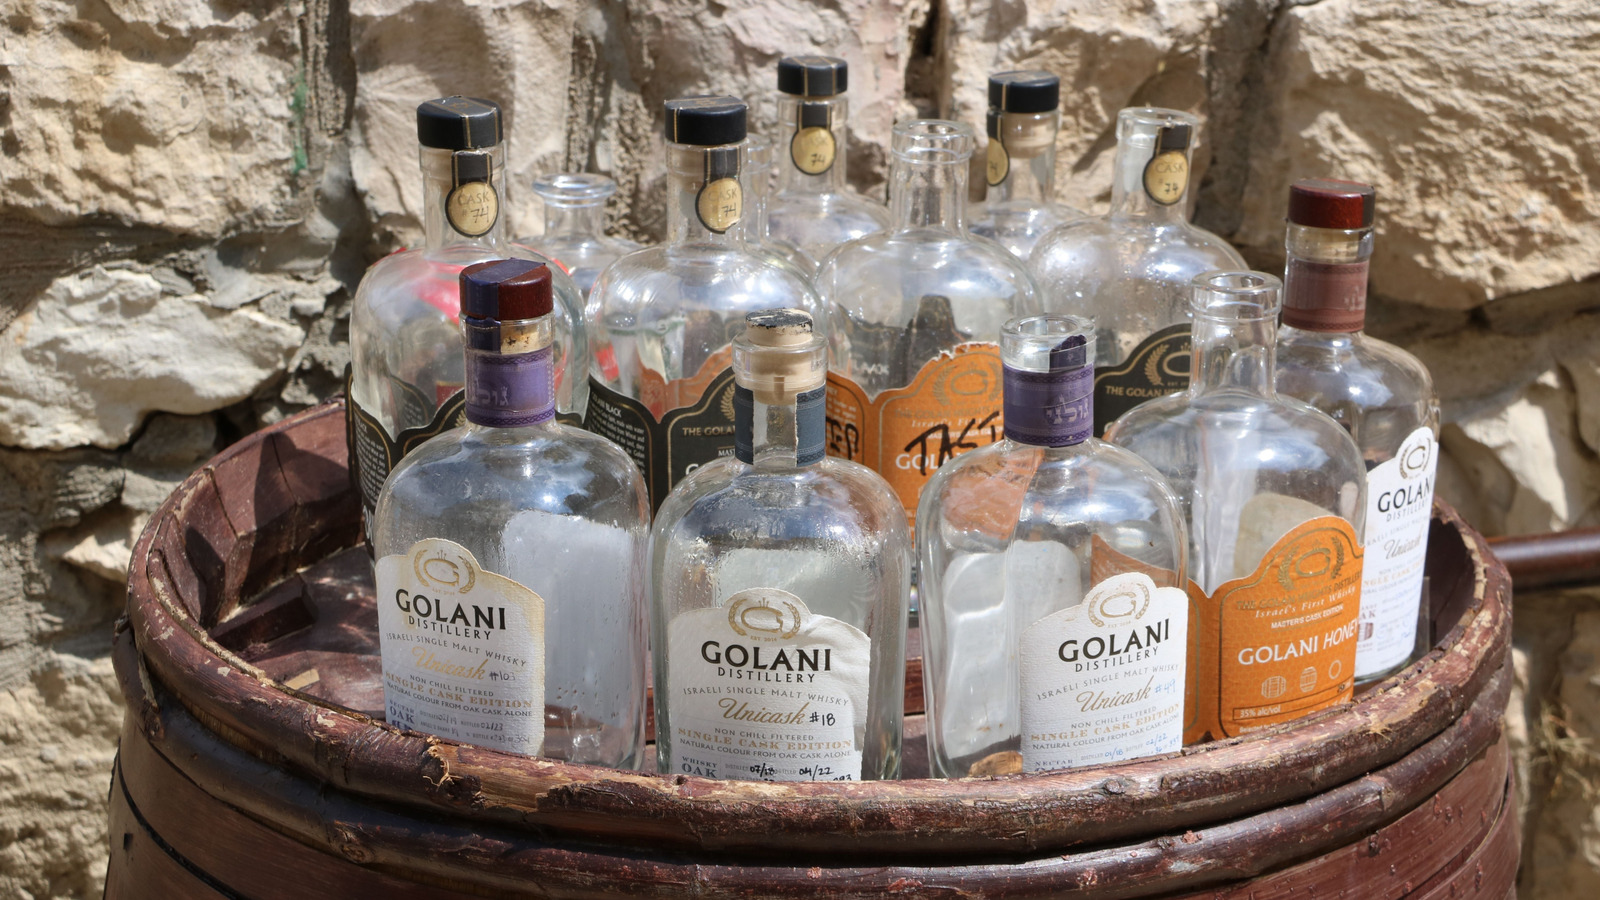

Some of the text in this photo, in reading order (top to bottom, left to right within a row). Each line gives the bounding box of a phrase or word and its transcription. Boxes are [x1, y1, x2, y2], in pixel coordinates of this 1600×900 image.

[1154, 162, 1184, 174] CASK
[458, 191, 490, 206] CASK
[707, 188, 737, 200] CASK
[470, 205, 489, 223] 74
[721, 202, 737, 217] 74
[1105, 385, 1125, 396] THE
[1125, 387, 1161, 397] GOLAN
[682, 427, 702, 436] THE
[1377, 477, 1430, 513] GOLAN
[395, 588, 506, 630] GOLANI
[1236, 600, 1257, 610] THE
[1259, 596, 1295, 609] GOLAN
[1255, 604, 1297, 619] Israel's
[1301, 598, 1324, 611] First
[1329, 586, 1356, 602] Whisky
[1305, 613, 1322, 623] CASK
[1322, 604, 1344, 617] EDITION
[408, 615, 491, 640] DISTILLERY
[385, 632, 527, 667] ISRAELI SINGLE MALT WHISKY
[1058, 618, 1170, 663] GOLANI
[1238, 636, 1318, 666] GOLANI
[411, 646, 490, 681] Unicask
[701, 640, 831, 672] GOLANI
[1075, 646, 1158, 673] DISTILLERY
[409, 674, 494, 697] NON CHILL FILTERED
[717, 667, 815, 683] DISTILLERY
[1037, 663, 1179, 701] ISRAELI SINGLE MALT WHISKY
[385, 671, 533, 709] SINGLE CASK EDITION
[386, 681, 412, 697] NATURAL
[412, 692, 440, 705] COLOUR
[441, 700, 462, 711] FROM
[463, 705, 480, 713] OAK
[481, 708, 502, 716] CASK
[683, 686, 849, 706] ISRAELI SINGLE MALT WHISKY
[1075, 675, 1154, 713] Unicask
[389, 700, 414, 714] NECTAR
[389, 705, 415, 724] OAK
[718, 697, 836, 726] Unicask #18
[1095, 717, 1119, 726] CHILL
[1122, 706, 1157, 721] FILTERED
[1240, 708, 1256, 718] 35%
[480, 721, 504, 731] 02/23
[1030, 703, 1179, 742] SINGLE CASK EDITION
[678, 727, 852, 750] SINGLE CASK EDITION
[714, 728, 814, 741] NON CHILL FILTERED
[1032, 742, 1070, 750] NATURAL
[1073, 736, 1105, 747] COLOUR
[1107, 732, 1127, 742] FROM
[1128, 728, 1144, 736] OAK
[1145, 721, 1162, 732] CASK
[679, 738, 714, 751] NATURAL
[717, 746, 750, 756] COLOUR
[752, 749, 777, 759] FROM
[778, 751, 797, 759] OAK
[800, 752, 822, 760] CASK
[681, 763, 717, 779] OAK
[682, 756, 718, 768] WHISKY
